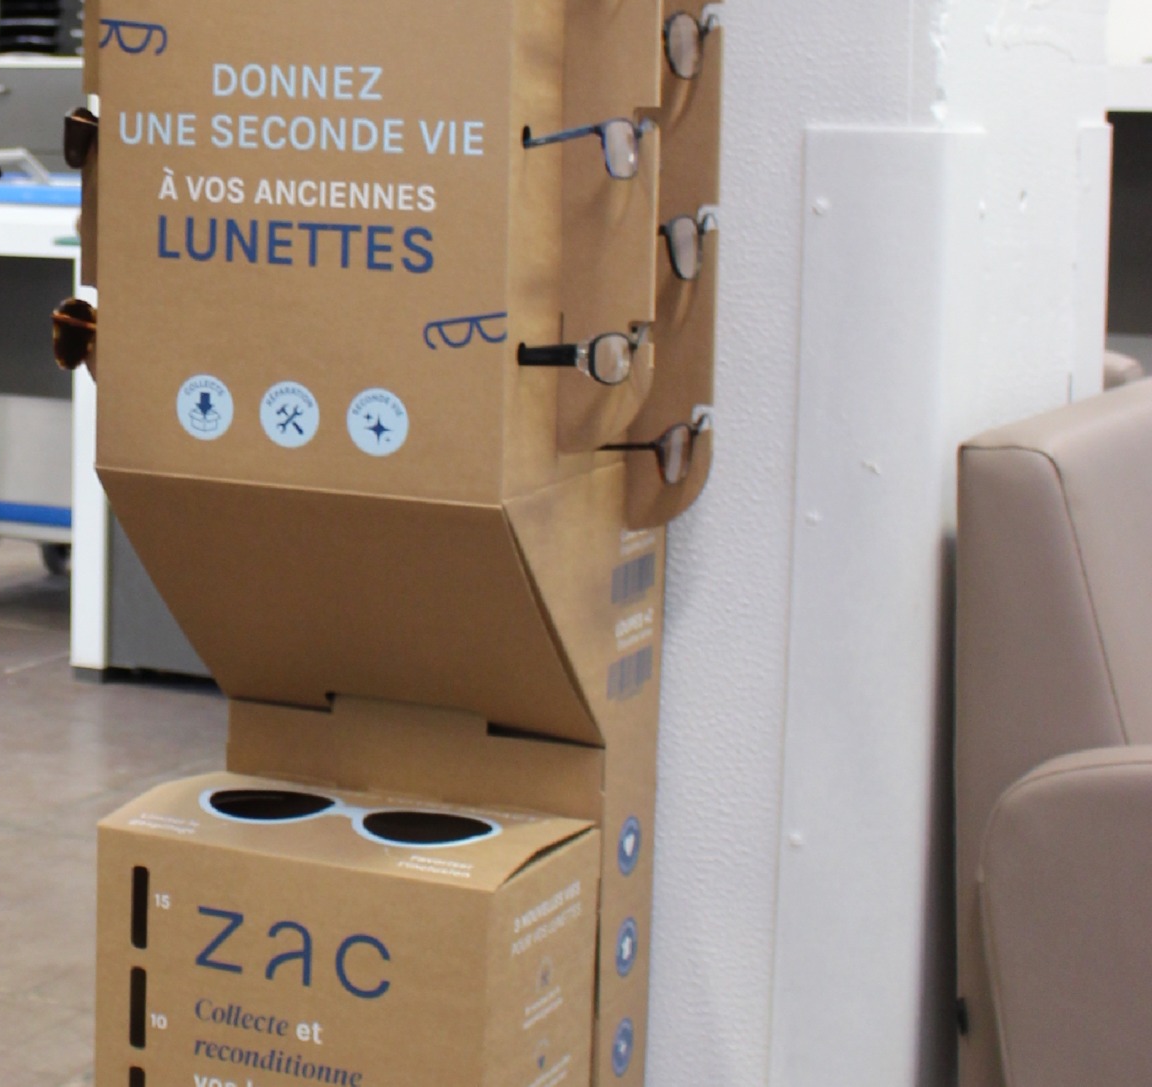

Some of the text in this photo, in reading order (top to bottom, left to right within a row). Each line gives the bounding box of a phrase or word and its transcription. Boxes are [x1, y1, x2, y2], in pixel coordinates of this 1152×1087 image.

[213, 63, 383, 100] DONNEZ
[119, 112, 484, 156] UNE SECONDE VIE
[159, 167, 437, 211] À VOS ANCIENNES
[158, 215, 434, 273] LUNETTES
[155, 893, 171, 910] 15
[195, 906, 391, 999] zac
[151, 1013, 168, 1030] 10
[195, 998, 323, 1044] Collecte et
[193, 1039, 363, 1087] reconditionne
